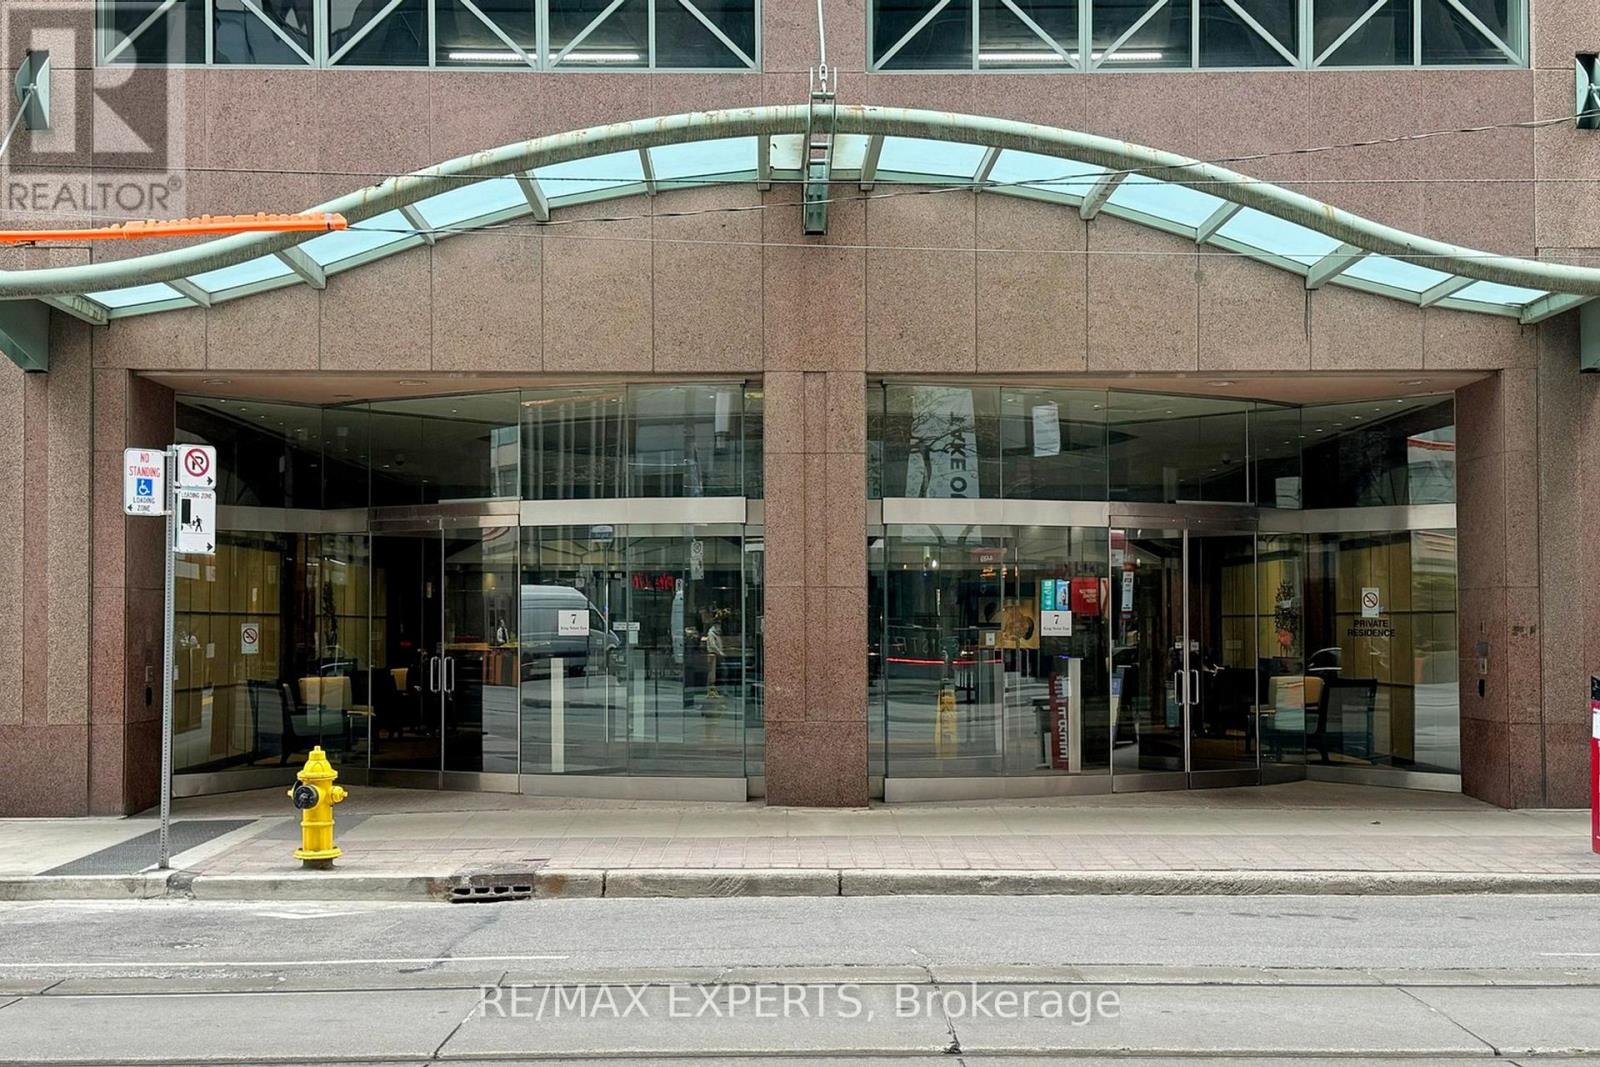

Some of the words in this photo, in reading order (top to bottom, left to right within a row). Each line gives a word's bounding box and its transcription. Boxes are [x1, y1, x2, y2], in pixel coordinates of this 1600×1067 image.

[140, 453, 149, 463] NO
[128, 466, 161, 477] STANDING
[570, 613, 577, 625] 7
[1053, 614, 1060, 625] 7
[1353, 620, 1388, 628] PRIVATE
[1347, 629, 1396, 637] RESIDENCE
